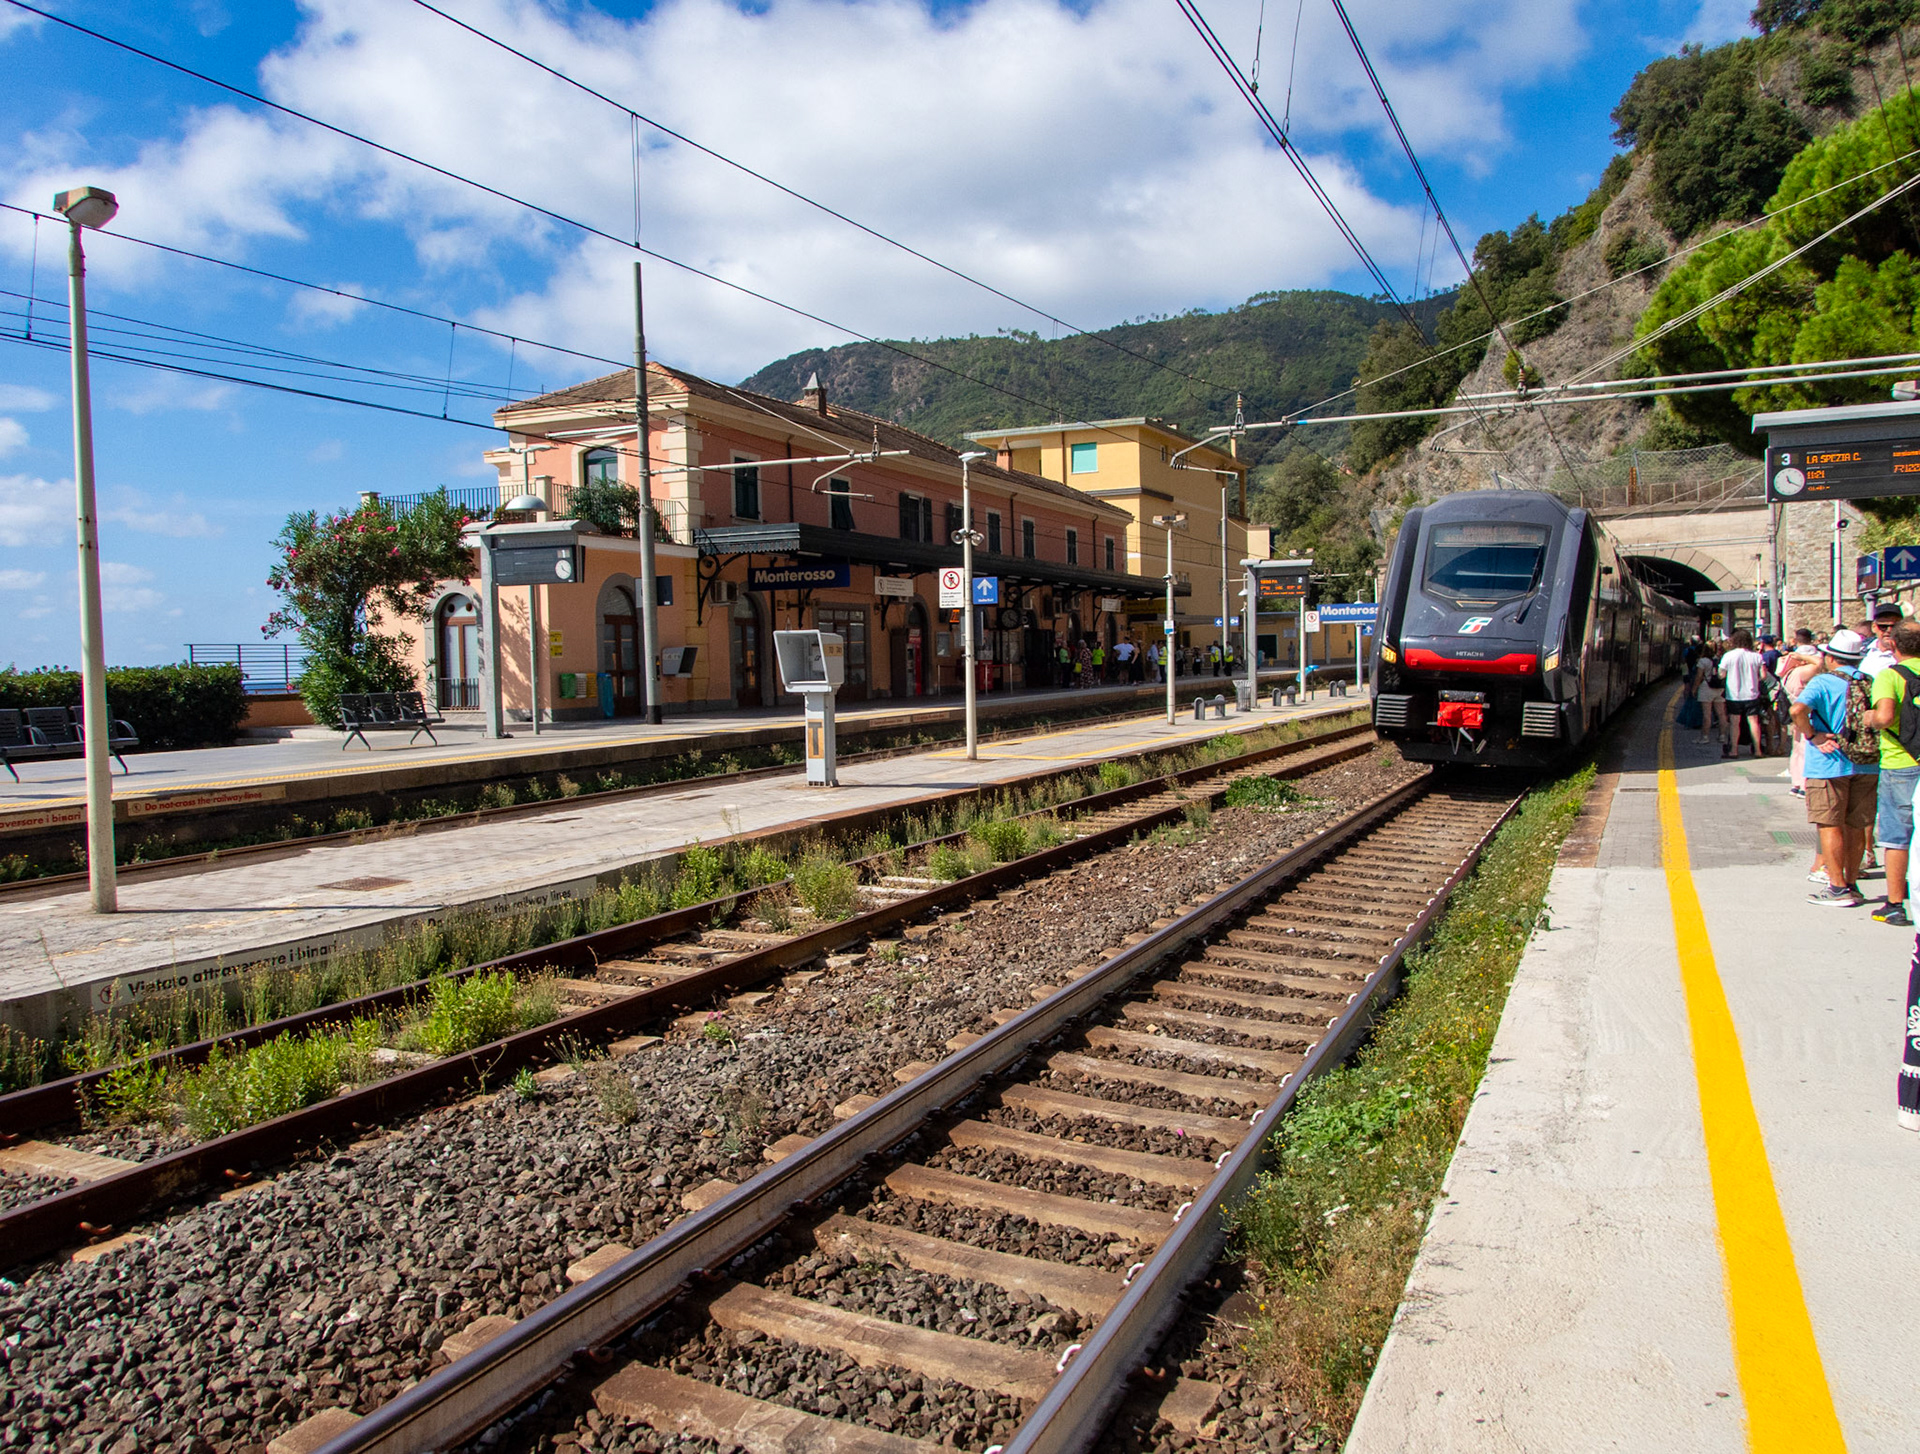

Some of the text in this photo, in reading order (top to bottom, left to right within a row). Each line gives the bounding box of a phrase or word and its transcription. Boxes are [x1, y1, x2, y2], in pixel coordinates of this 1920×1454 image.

[1781, 453, 1791, 466] 3
[1806, 455, 1818, 464] LA
[1820, 453, 1851, 463] SPEZIA
[562, 549, 566, 558] 1
[754, 570, 836, 583] Monterosso
[808, 722, 822, 755] T
[145, 803, 157, 811] Do
[176, 800, 196, 808] cross
[198, 797, 210, 805] the
[213, 794, 243, 804] railway
[244, 791, 262, 800] lines
[52, 812, 81, 823] binari
